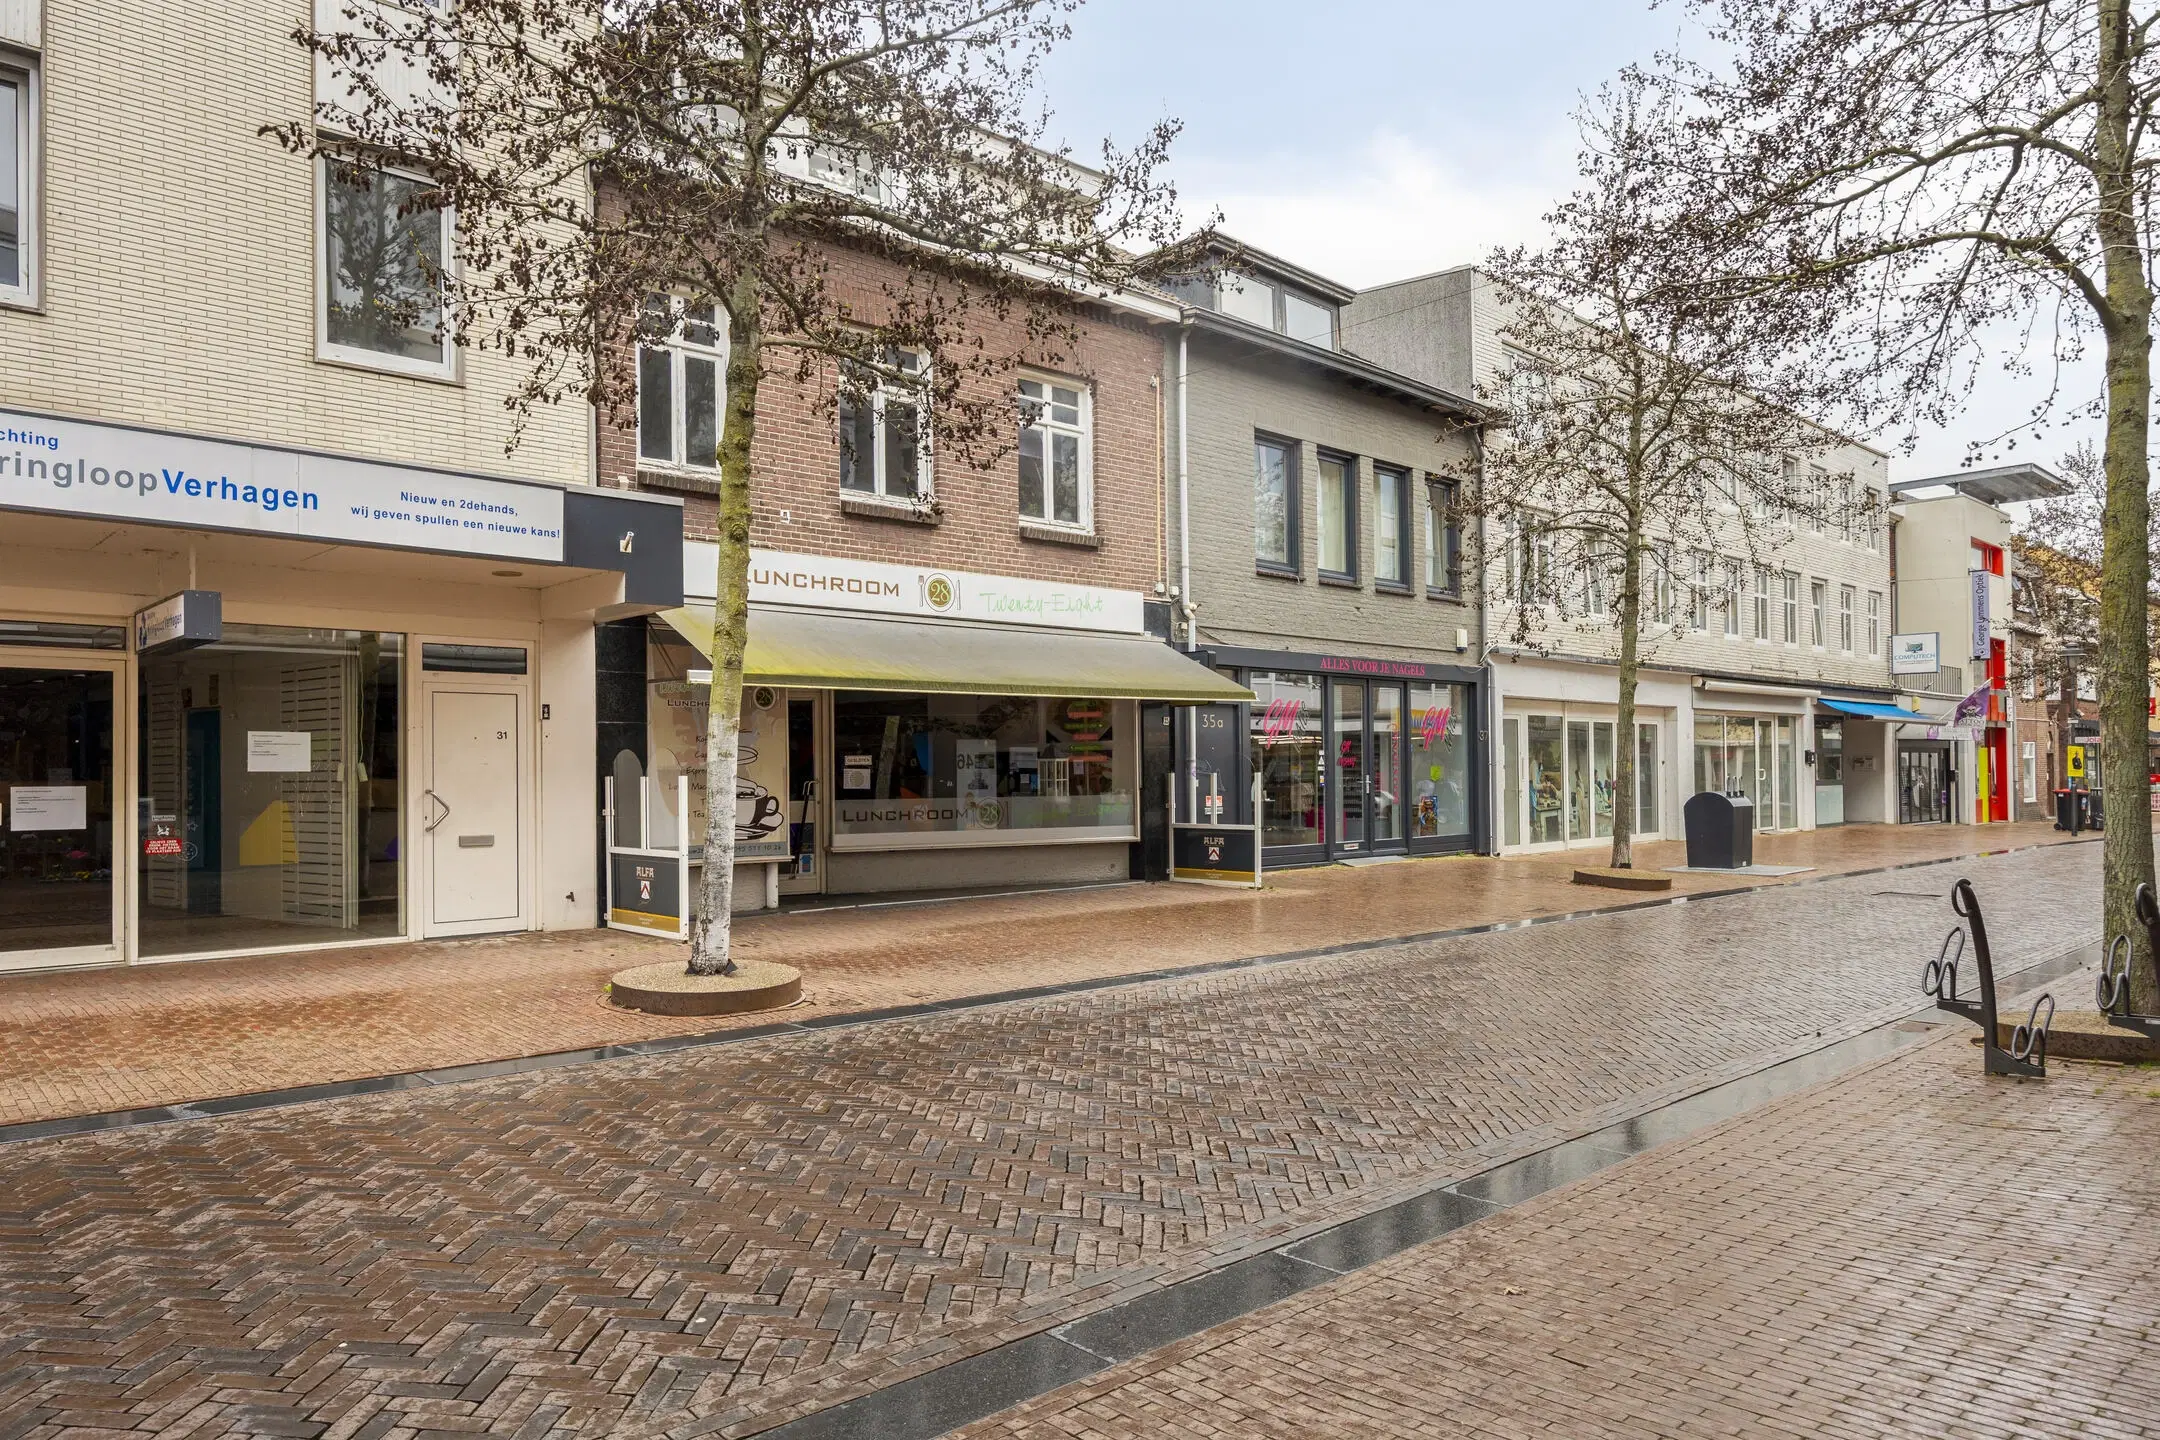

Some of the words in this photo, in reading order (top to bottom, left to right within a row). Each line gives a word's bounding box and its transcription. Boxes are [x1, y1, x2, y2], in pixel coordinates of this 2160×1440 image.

[0, 429, 59, 450] chting
[0, 451, 318, 511] ringloopVerhagen
[400, 491, 437, 505] Nieuw
[441, 498, 455, 507] en
[460, 499, 518, 517] 2dehands,
[351, 505, 369, 518] wij
[373, 508, 411, 521] geven
[415, 513, 459, 527] spullen
[463, 519, 484, 530] een
[488, 521, 527, 535] nieuwe
[531, 526, 561, 539] kans!
[747, 569, 900, 598] UNCHROOM
[930, 583, 950, 603] 28
[1320, 658, 1350, 671] ALLES
[1352, 660, 1378, 673] VOOR
[1380, 662, 1390, 674] JE
[1392, 663, 1425, 676] NAGELS
[667, 699, 709, 707] LUNCHR
[1202, 714, 1224, 728] 35a
[496, 731, 508, 740] 31
[1479, 730, 1489, 741] 37
[842, 807, 969, 823] LUNCHROOM
[1203, 836, 1225, 846] ALFA
[635, 866, 655, 878] ALFA
